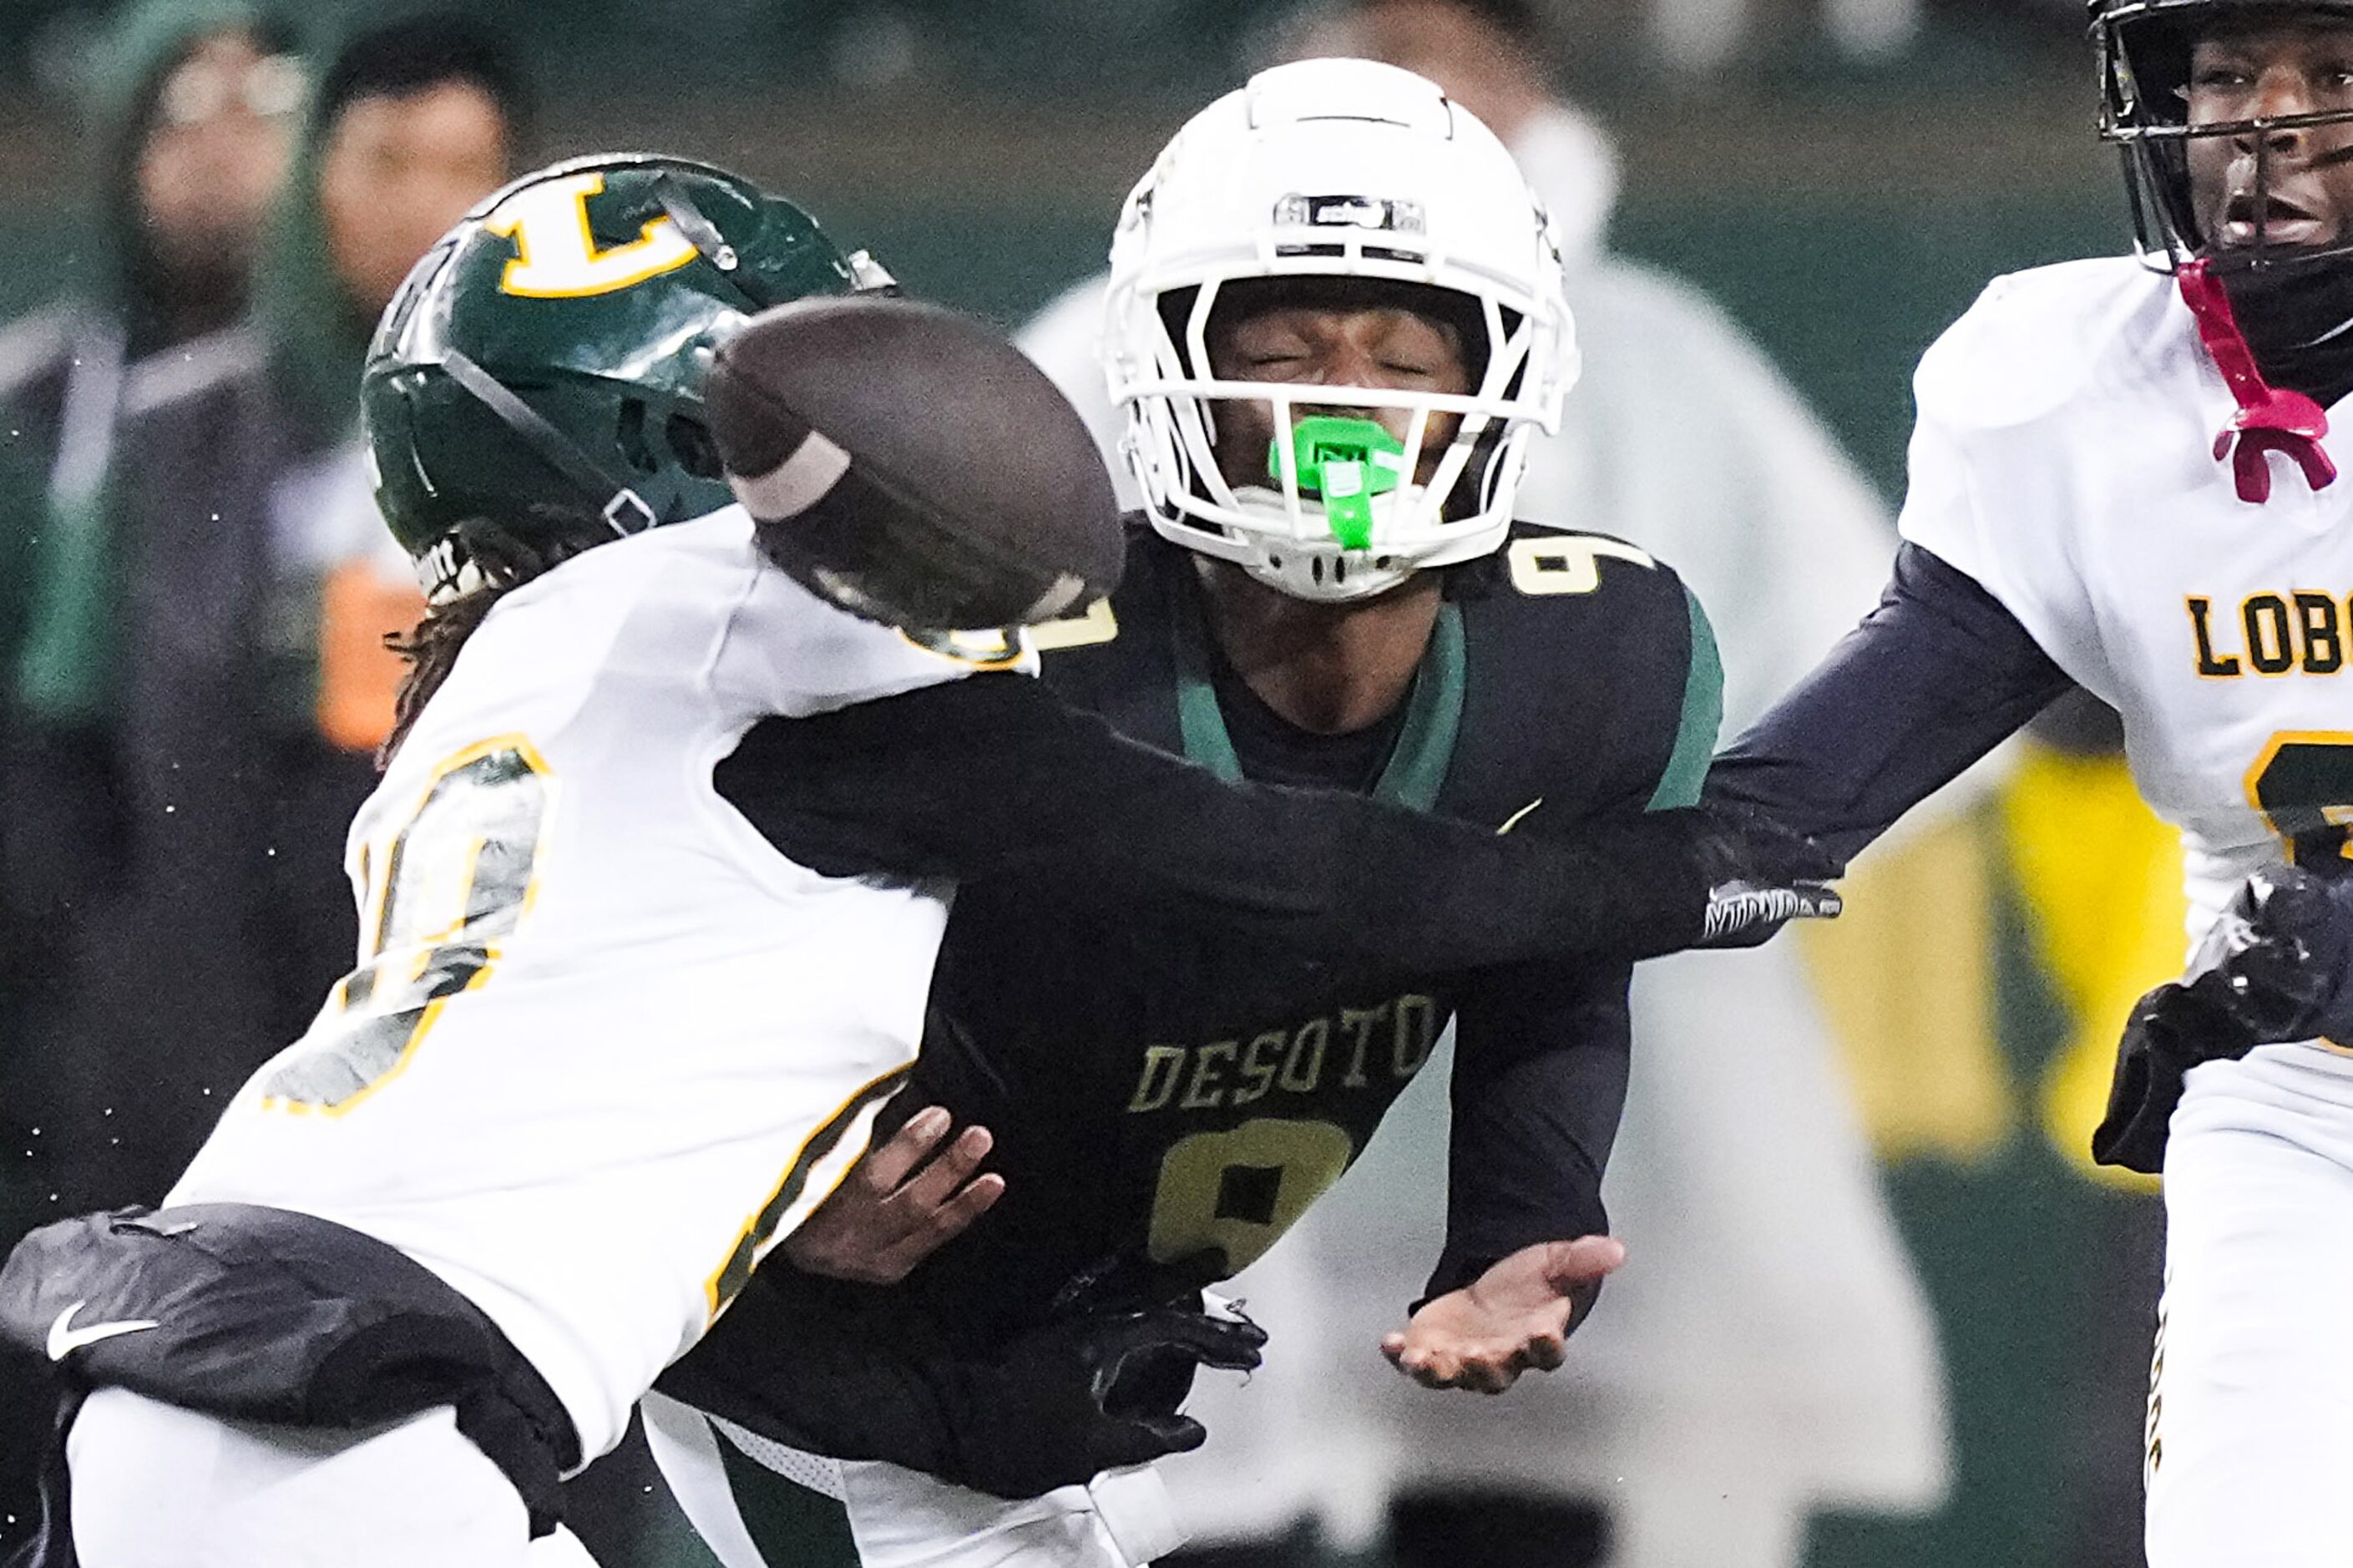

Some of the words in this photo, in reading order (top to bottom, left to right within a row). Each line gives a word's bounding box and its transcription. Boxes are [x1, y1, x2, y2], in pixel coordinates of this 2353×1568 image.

[484, 171, 700, 298] L
[2183, 589, 2353, 680] LOB
[1128, 994, 1435, 1113] DESOTO
